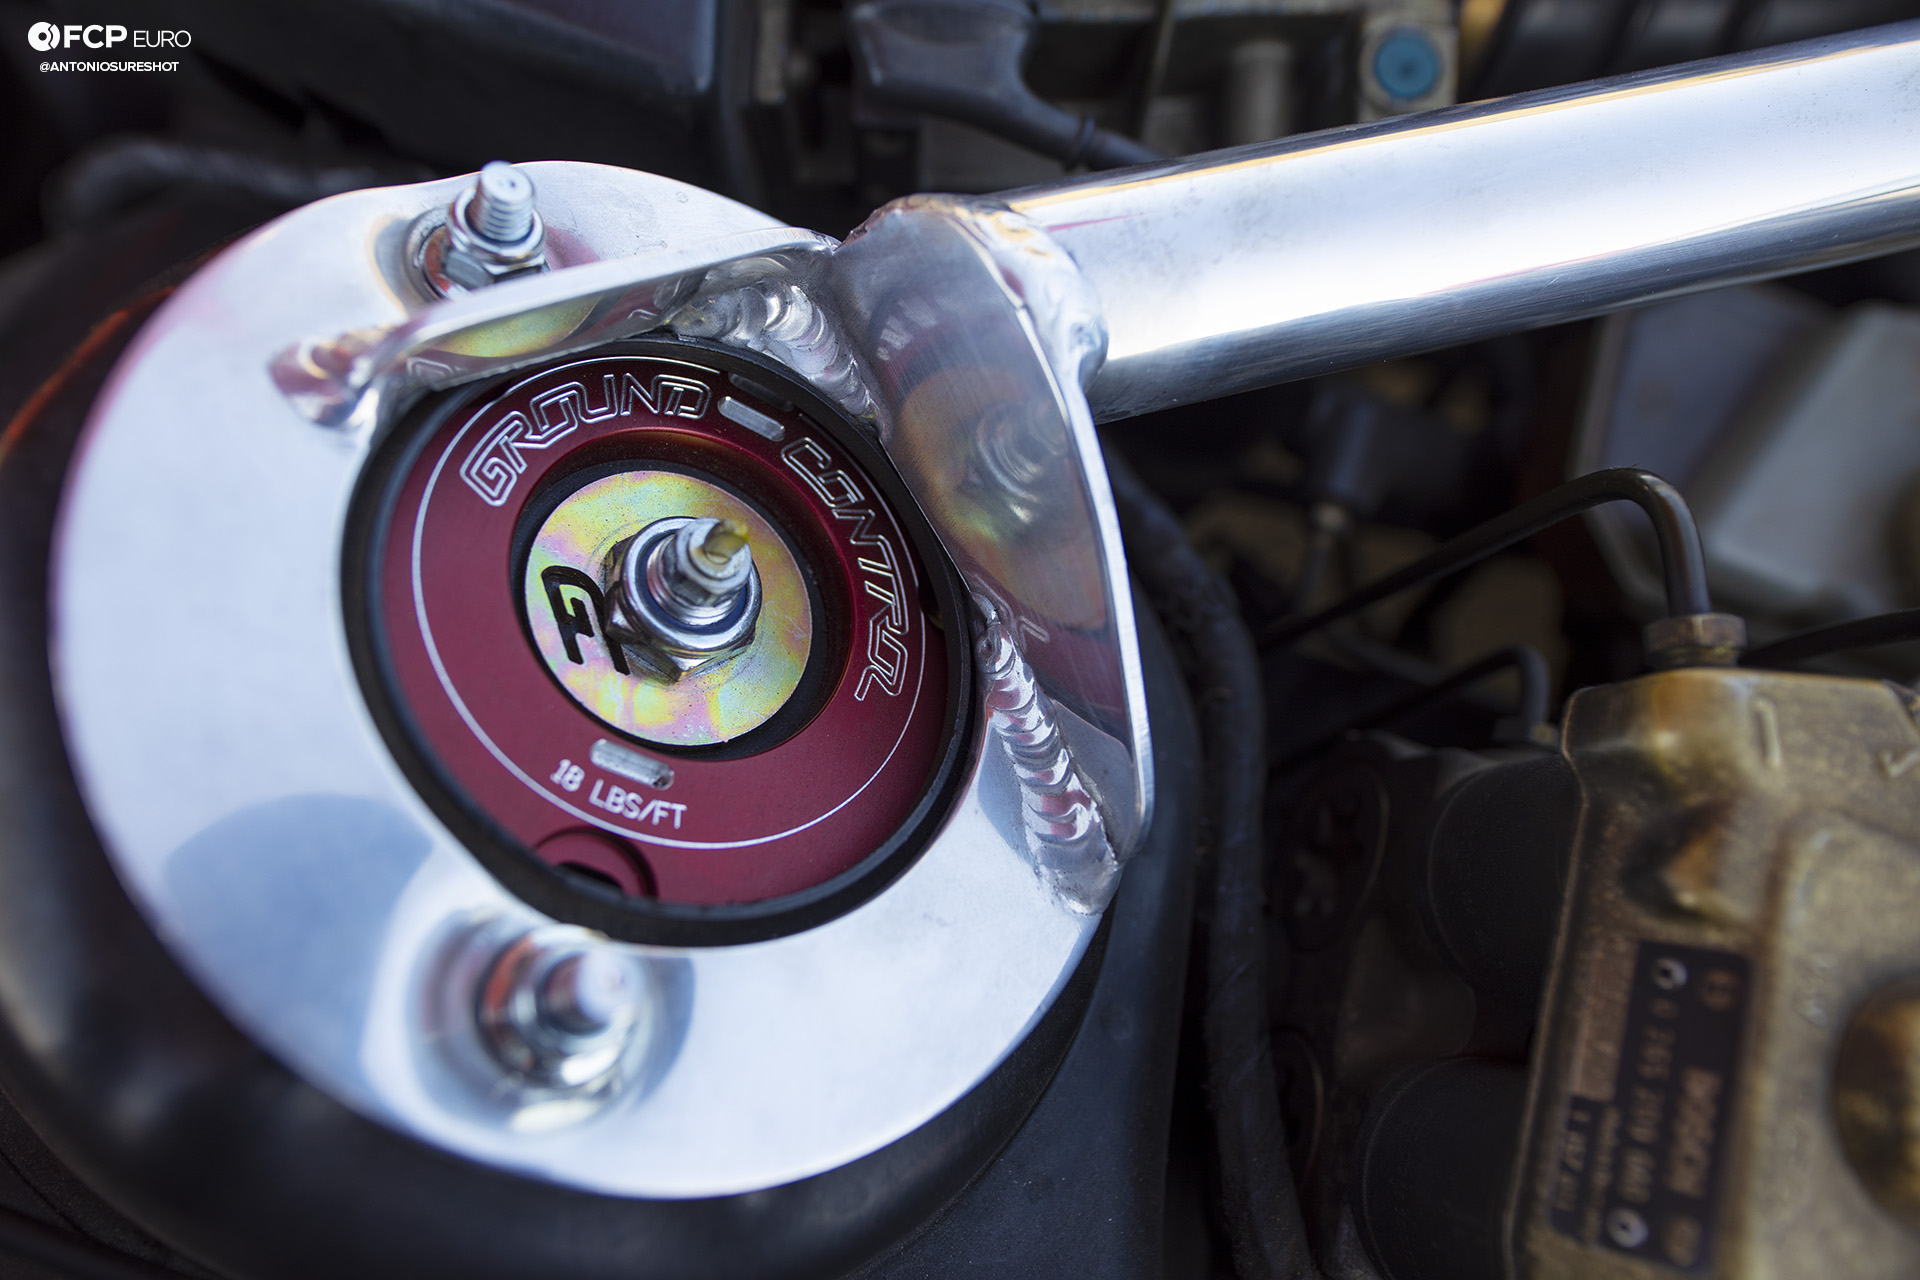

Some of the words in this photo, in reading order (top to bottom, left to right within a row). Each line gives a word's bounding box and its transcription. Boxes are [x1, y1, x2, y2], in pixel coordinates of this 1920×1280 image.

[459, 372, 712, 507] GROUND
[780, 436, 910, 702] CONTROL
[550, 758, 585, 793] 18
[588, 778, 688, 830] LBS/FT
